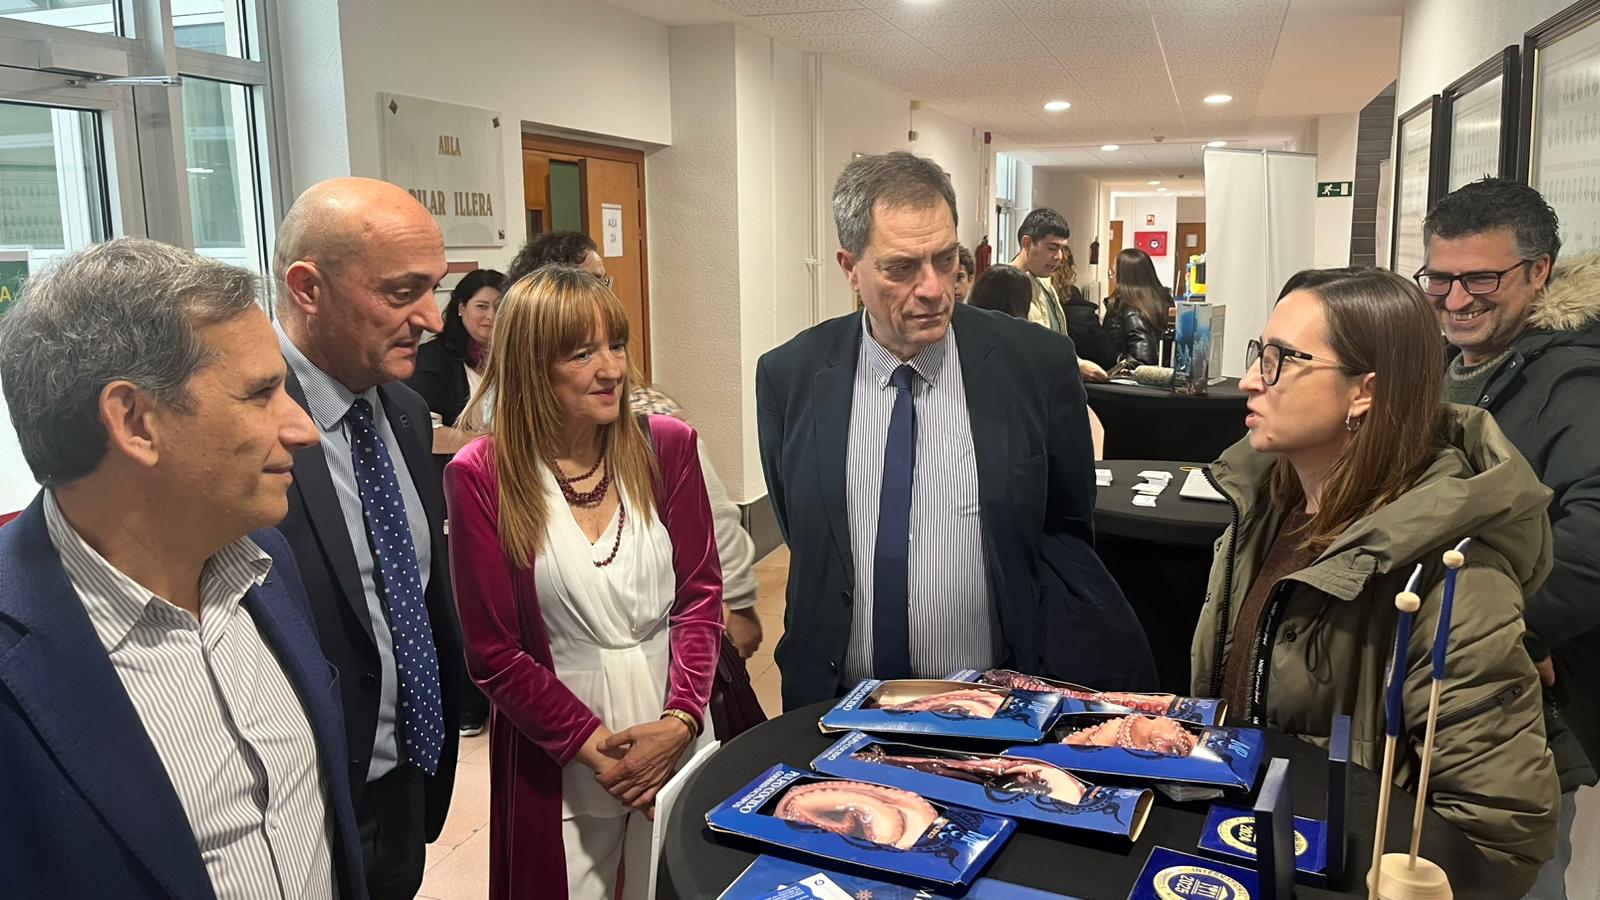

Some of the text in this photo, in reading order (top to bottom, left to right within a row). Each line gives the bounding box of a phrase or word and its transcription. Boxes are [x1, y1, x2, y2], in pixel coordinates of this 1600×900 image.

[438, 135, 461, 157] AULA
[453, 191, 494, 217] ILLERA
[739, 787, 775, 814] COCIDO
[1174, 874, 1195, 895] 2025
